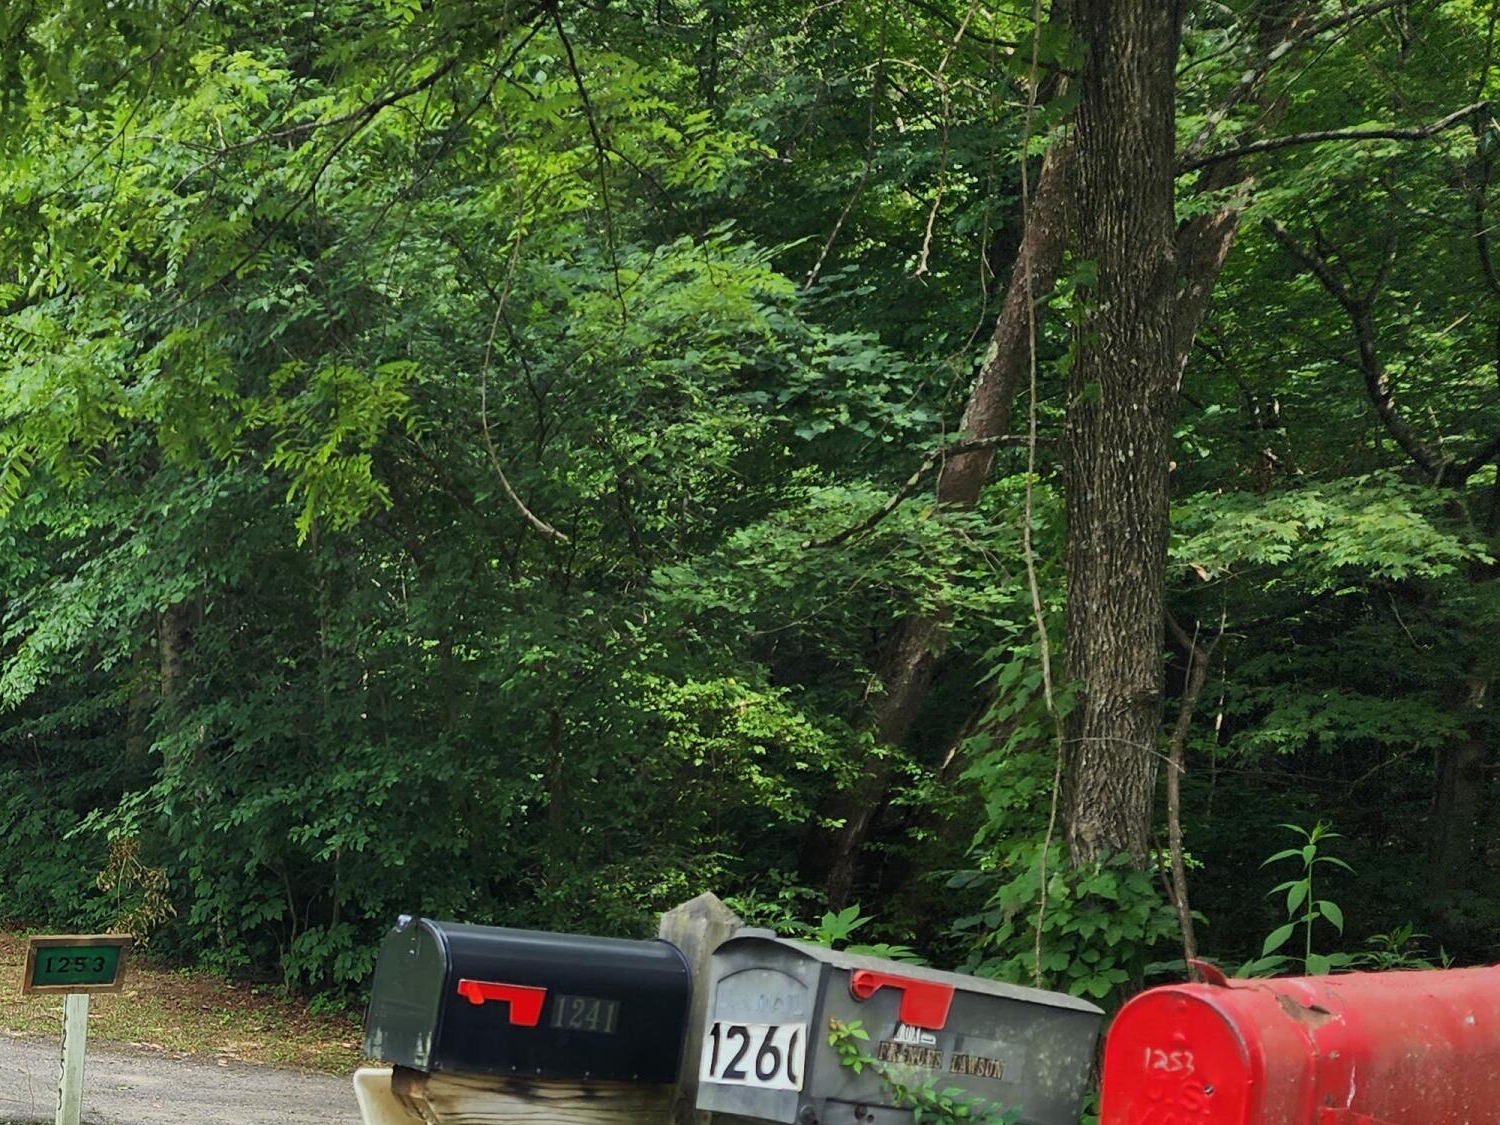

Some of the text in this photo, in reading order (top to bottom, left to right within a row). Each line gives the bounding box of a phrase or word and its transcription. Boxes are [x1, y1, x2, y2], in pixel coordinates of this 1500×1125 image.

[44, 956, 106, 974] 1253
[554, 996, 615, 1034] 1241
[1144, 1046, 1195, 1079] 1253
